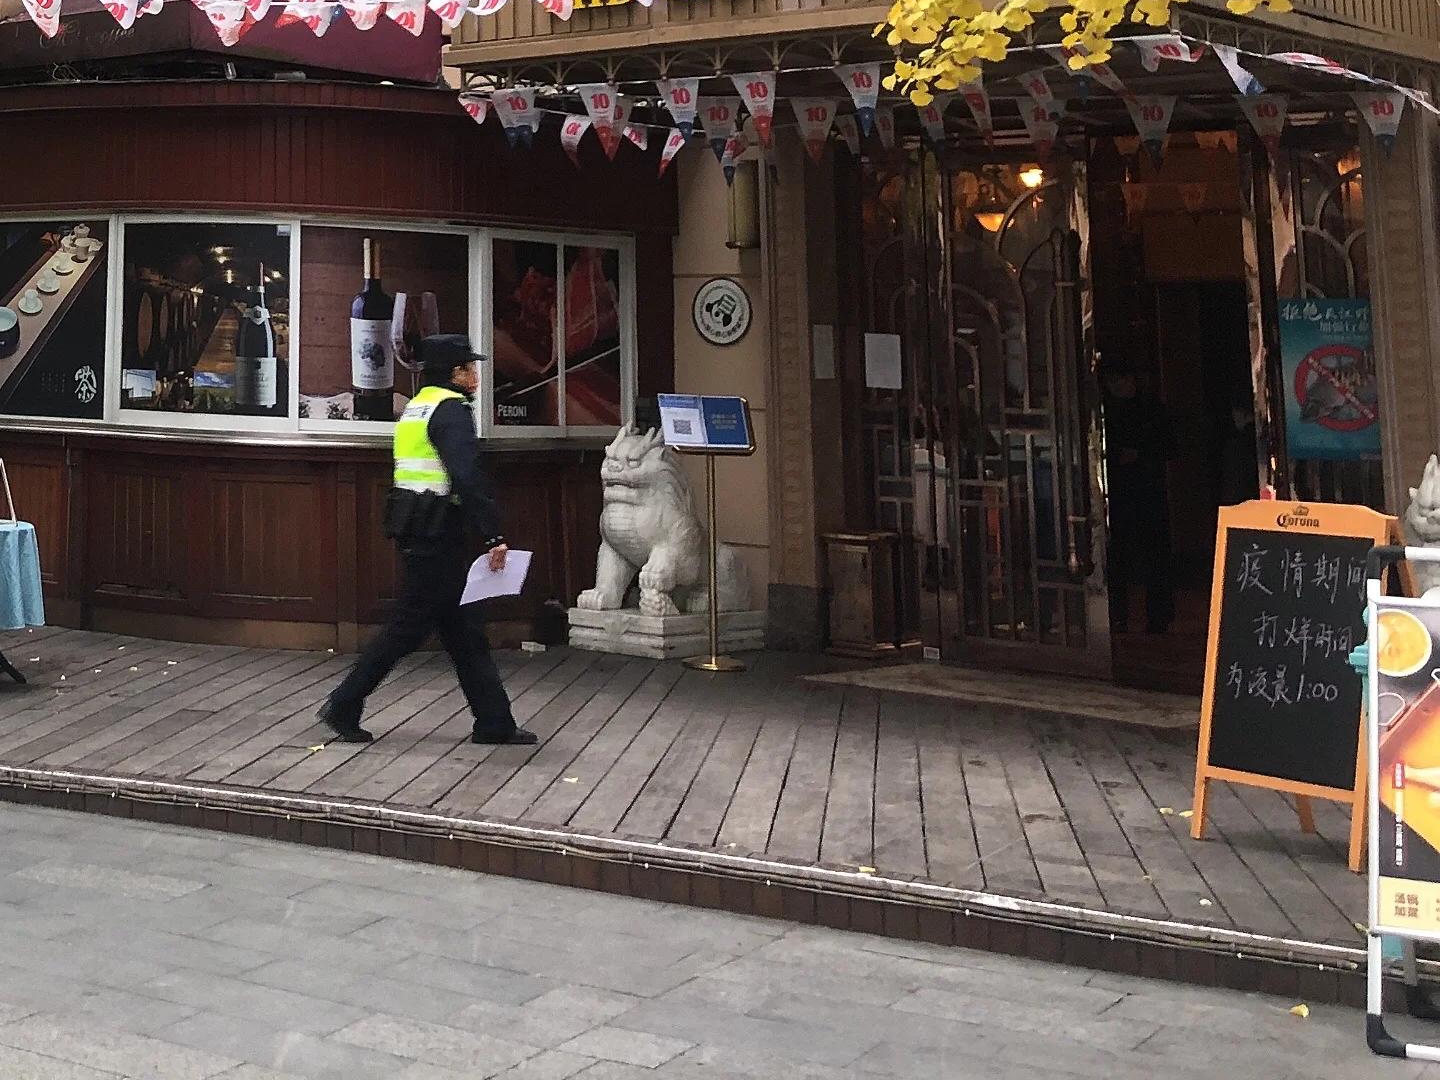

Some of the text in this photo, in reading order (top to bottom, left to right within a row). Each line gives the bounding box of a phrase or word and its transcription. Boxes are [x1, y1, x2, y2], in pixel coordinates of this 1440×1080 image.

[852, 71, 872, 88] 10
[671, 87, 690, 105] 10
[746, 81, 769, 99] 10
[591, 93, 610, 109] 10
[1369, 100, 1394, 116] 10
[706, 106, 729, 121] 10
[804, 106, 827, 121] 10
[1140, 104, 1164, 120] 10
[1256, 102, 1279, 118] 10
[498, 404, 527, 417] PERONI
[1277, 513, 1320, 528] Corona
[1236, 542, 1367, 604] 疫情期间
[1254, 612, 1353, 664] 打烊时间
